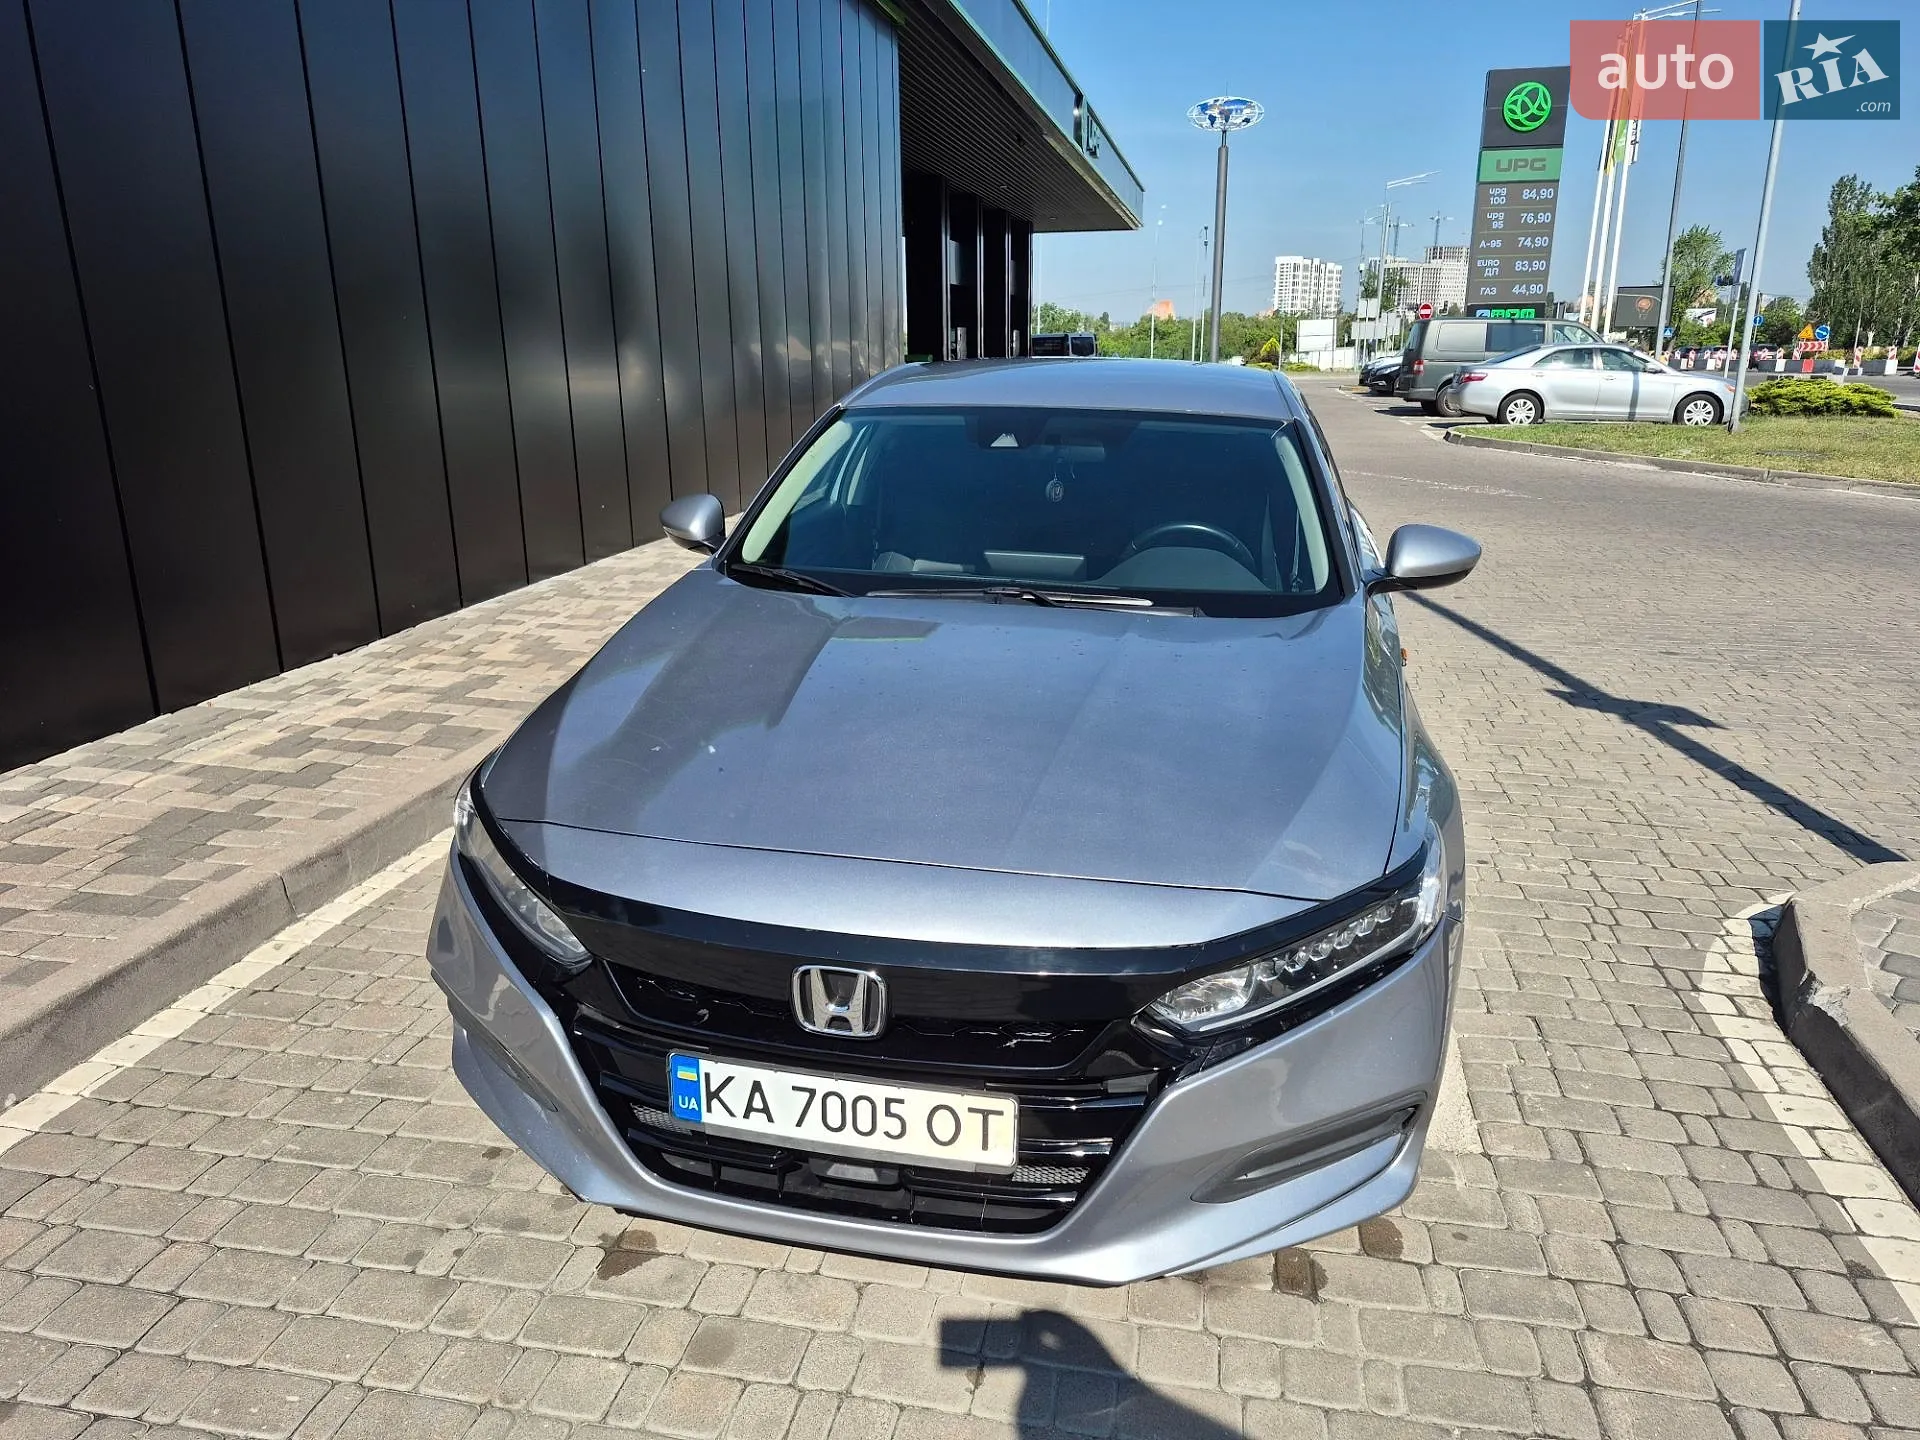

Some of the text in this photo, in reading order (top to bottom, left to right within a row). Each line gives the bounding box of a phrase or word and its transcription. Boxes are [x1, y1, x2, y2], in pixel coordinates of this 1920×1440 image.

[1495, 158, 1547, 172] UPG
[1489, 187, 1507, 196] upg
[1522, 188, 1554, 200] 84,90
[1489, 197, 1506, 205] 100
[1487, 212, 1504, 220] upg
[1520, 212, 1552, 225] 76,90
[1492, 221, 1504, 229] 95
[1518, 236, 1549, 249] 74,90
[1477, 259, 1500, 267] EURO
[1515, 260, 1546, 272] 83,90
[1484, 268, 1499, 277] ДП
[1480, 287, 1497, 295] ГАЗ
[1512, 284, 1544, 296] 44,90
[678, 1095, 699, 1112] UA
[704, 1071, 1005, 1152] KA 7005 OT
